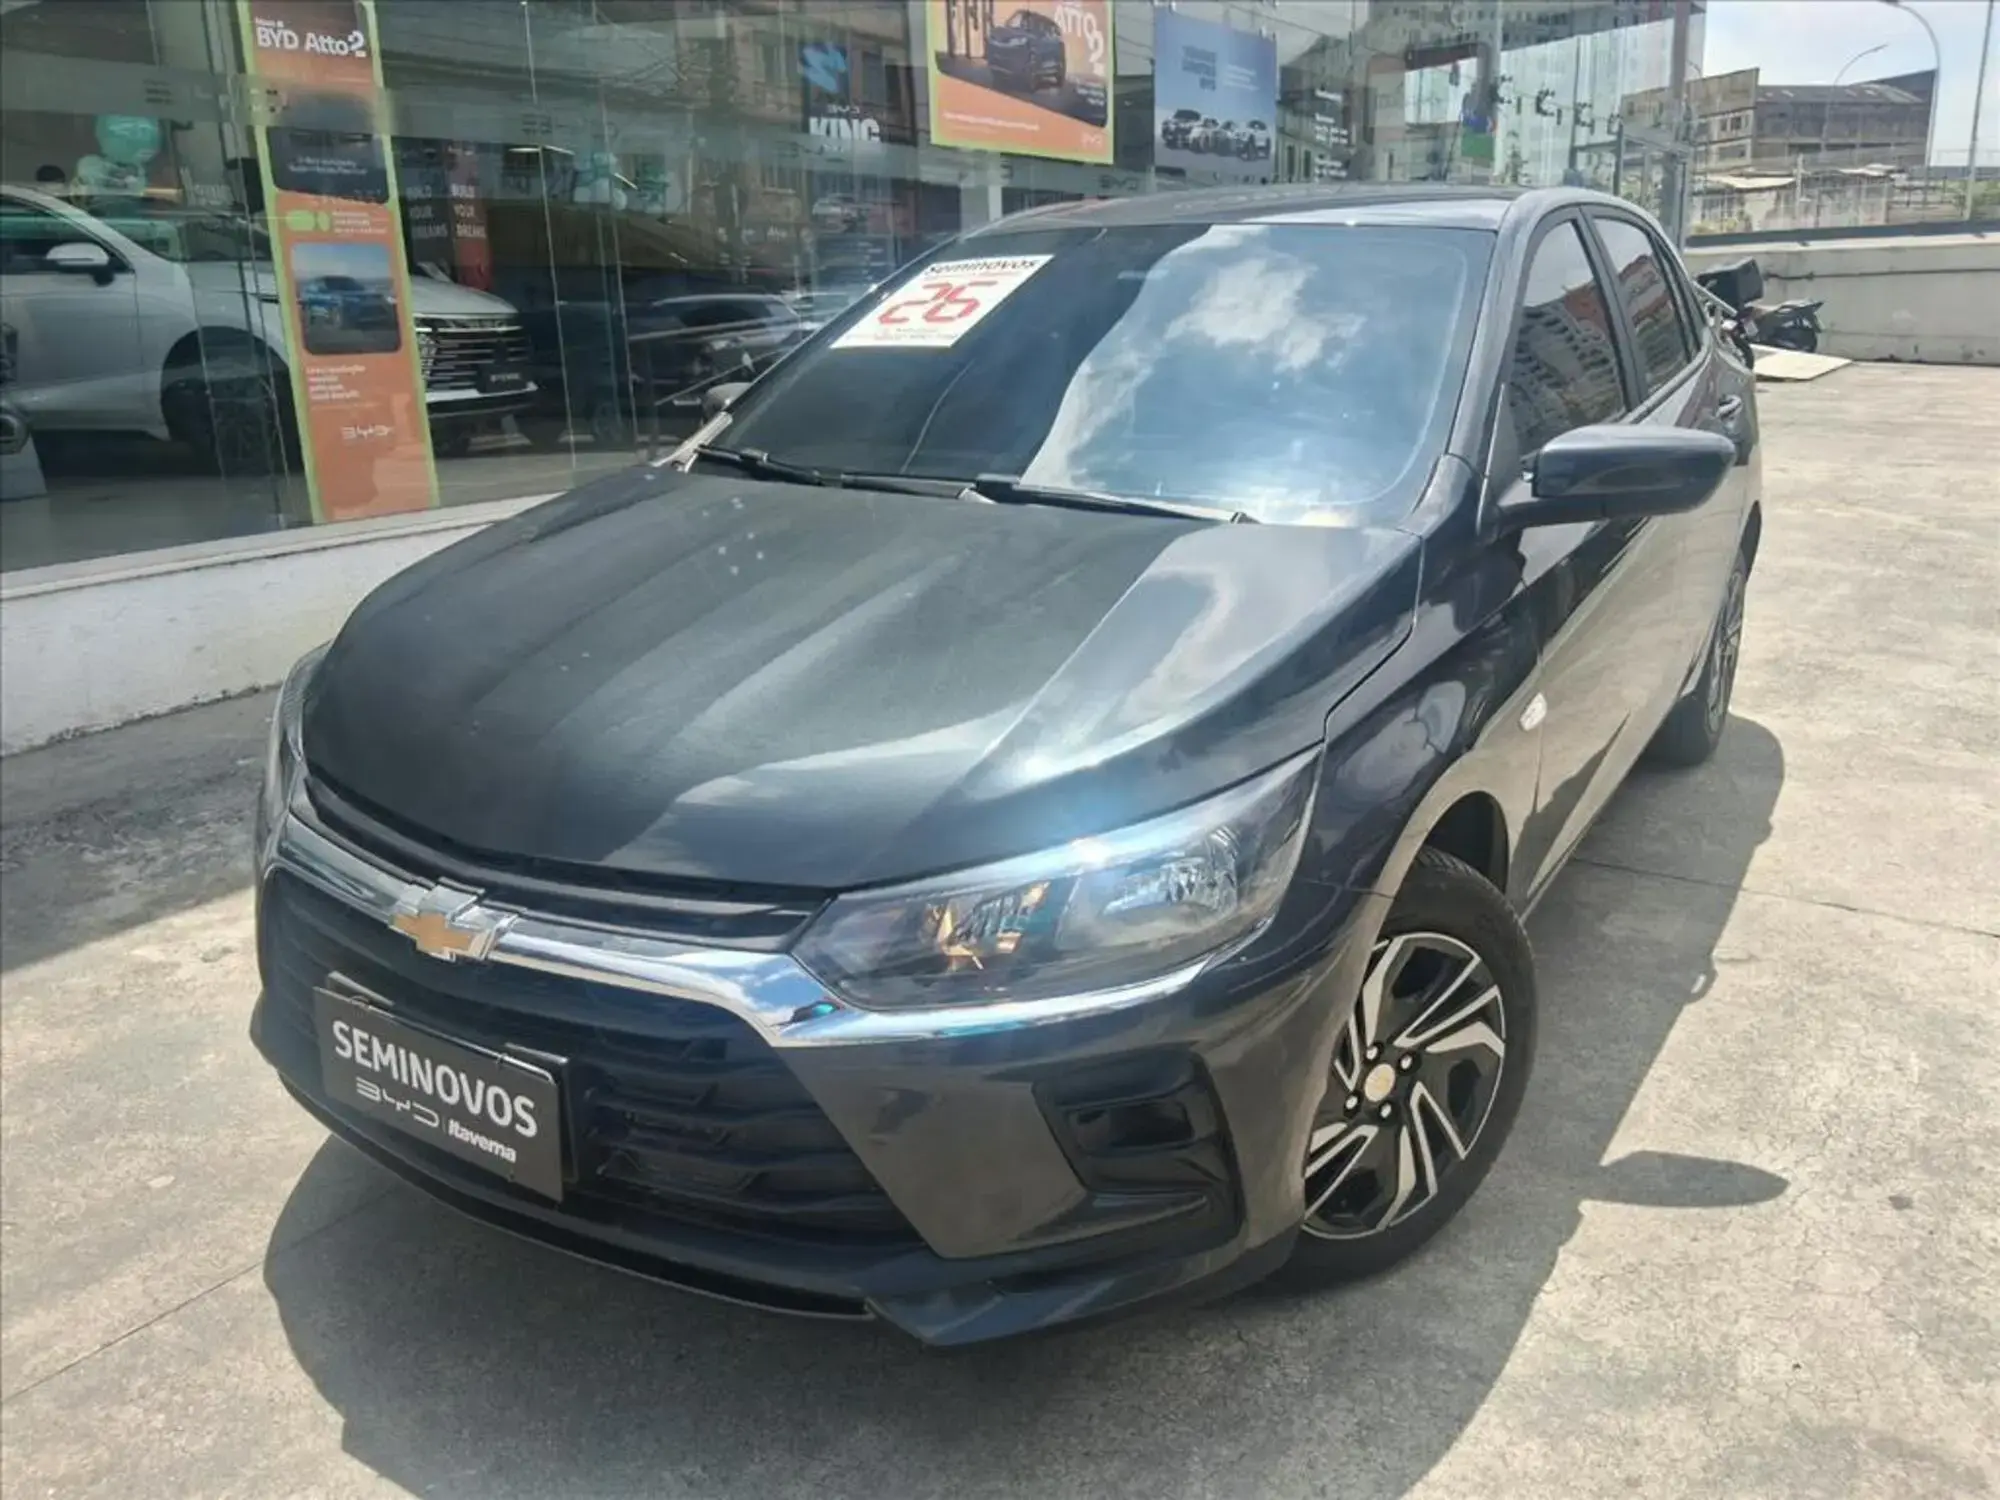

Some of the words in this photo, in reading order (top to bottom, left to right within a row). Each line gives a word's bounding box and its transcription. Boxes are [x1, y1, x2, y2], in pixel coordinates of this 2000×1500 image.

[256, 27, 299, 49] BYD
[877, 279, 999, 325] 26
[332, 1019, 539, 1138] SEMINOVOS
[355, 1076, 440, 1128] BYD
